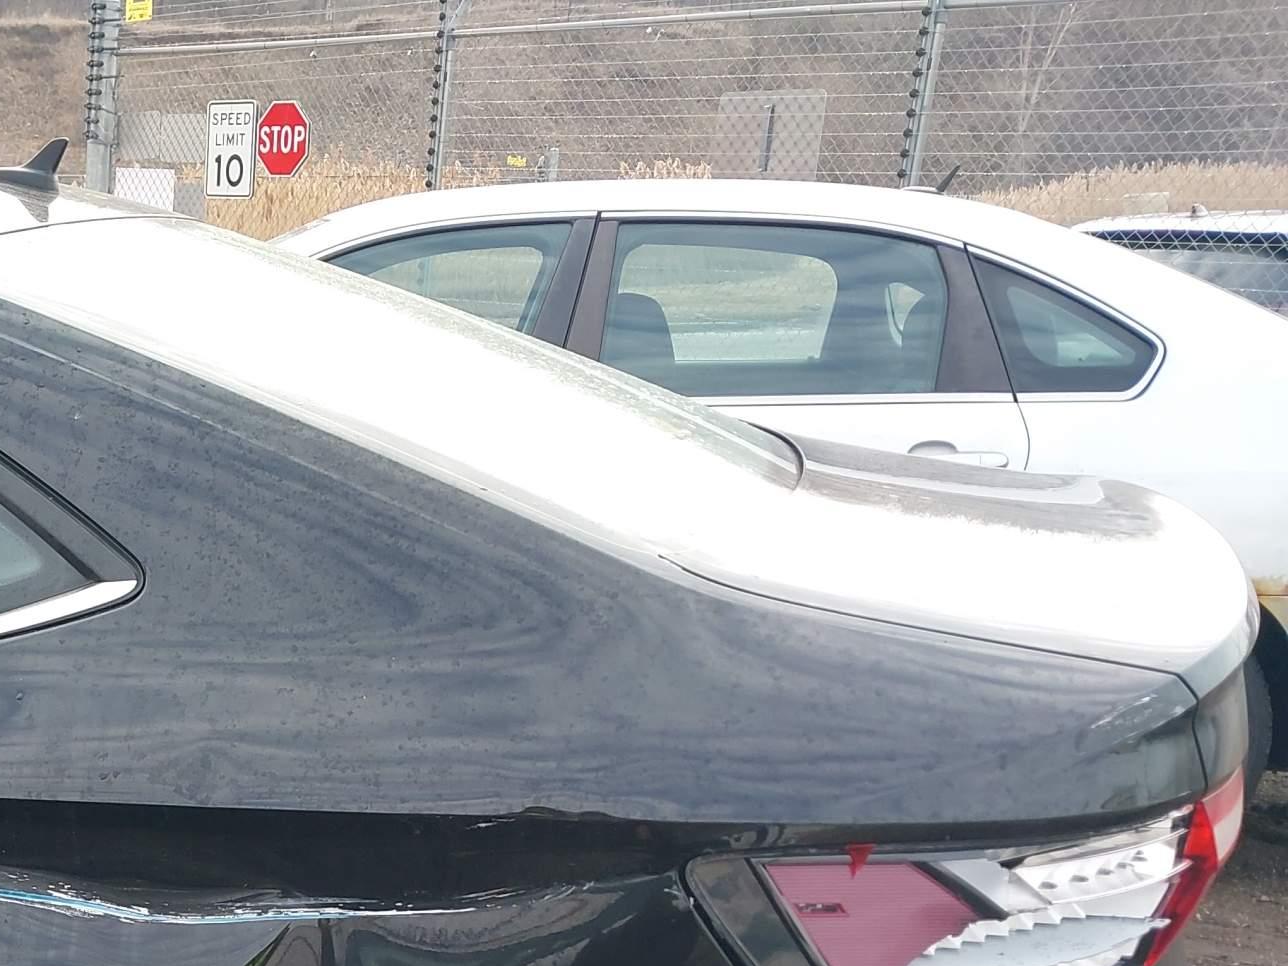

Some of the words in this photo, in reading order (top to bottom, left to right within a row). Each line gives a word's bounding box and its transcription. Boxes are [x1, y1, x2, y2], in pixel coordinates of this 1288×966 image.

[212, 112, 251, 126] SPEED
[215, 133, 246, 147] LIMIT
[259, 125, 305, 154] STOP
[215, 154, 244, 187] 10
